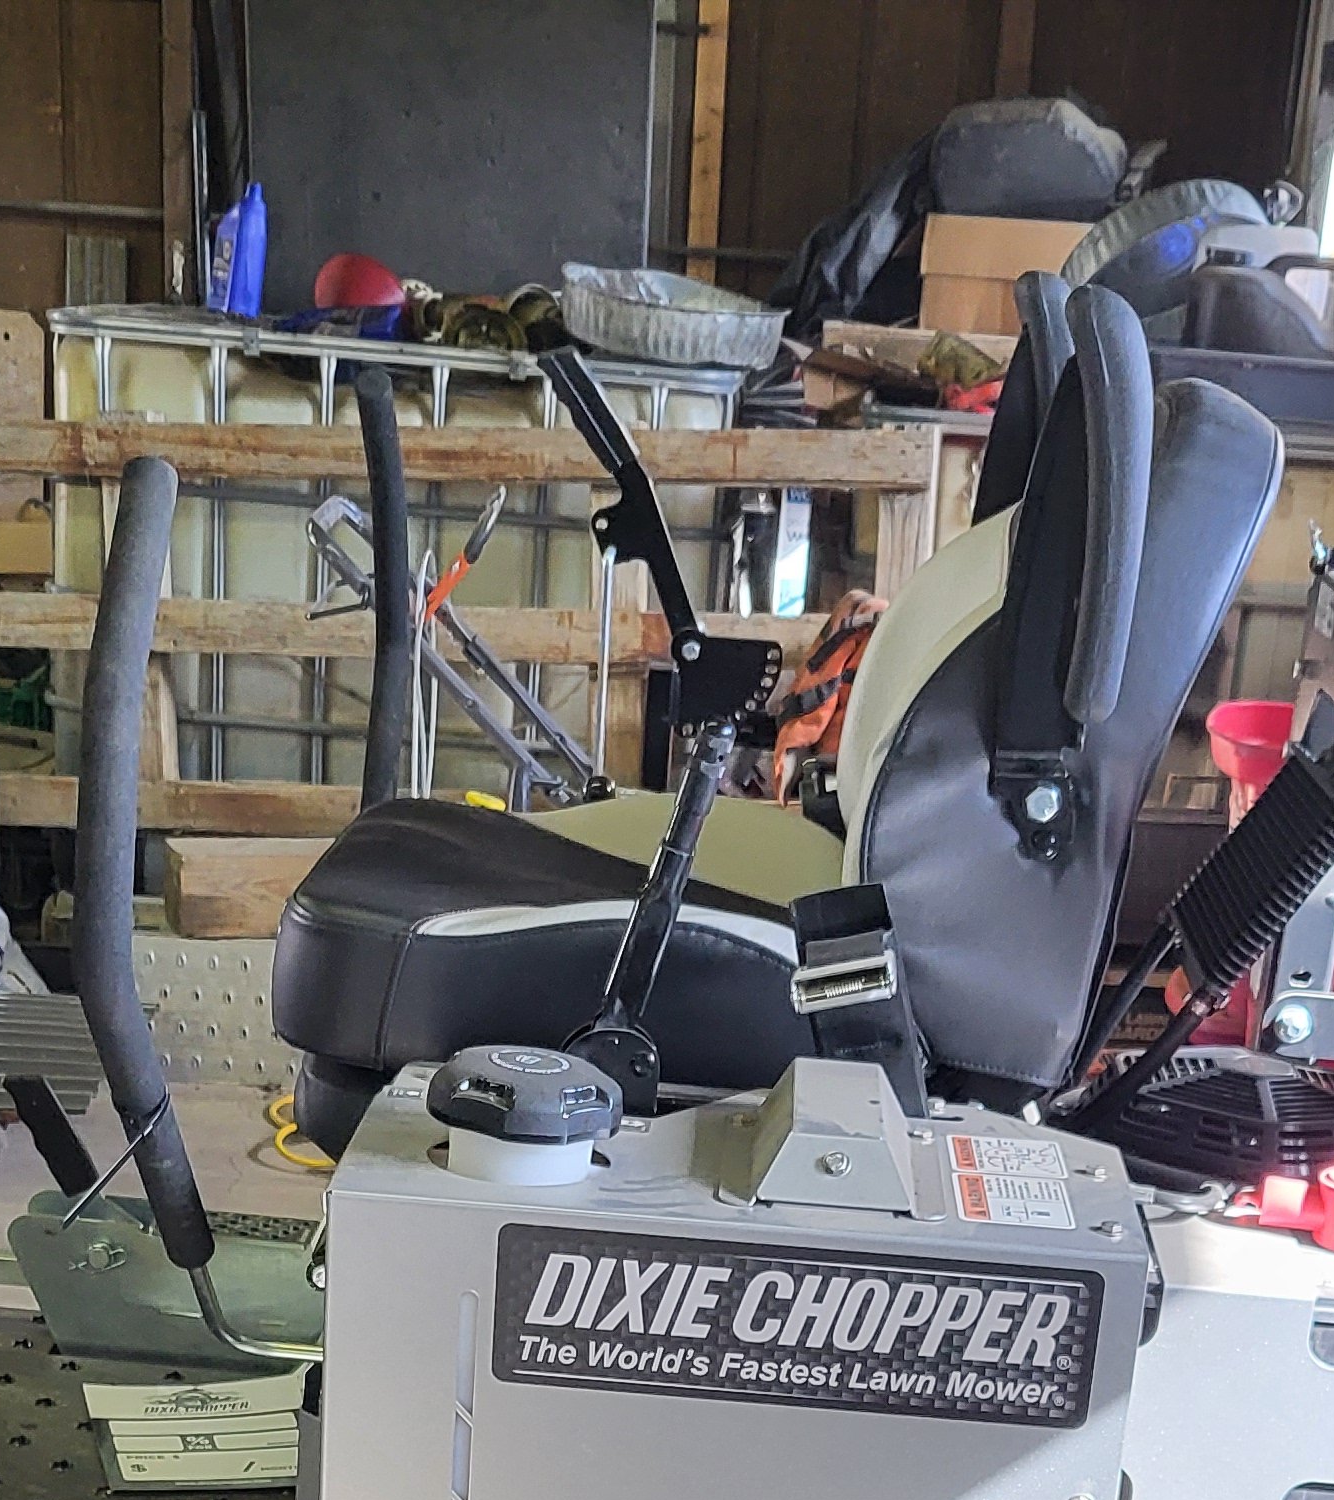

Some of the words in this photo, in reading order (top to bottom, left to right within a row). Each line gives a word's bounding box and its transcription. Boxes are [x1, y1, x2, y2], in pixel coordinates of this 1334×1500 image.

[524, 1252, 734, 1339] DIXIE
[732, 1270, 1071, 1368] CHOPPER
[519, 1335, 578, 1365] The
[587, 1340, 711, 1377] World's
[718, 1353, 843, 1388] Fastest
[847, 1363, 937, 1395] Lawn
